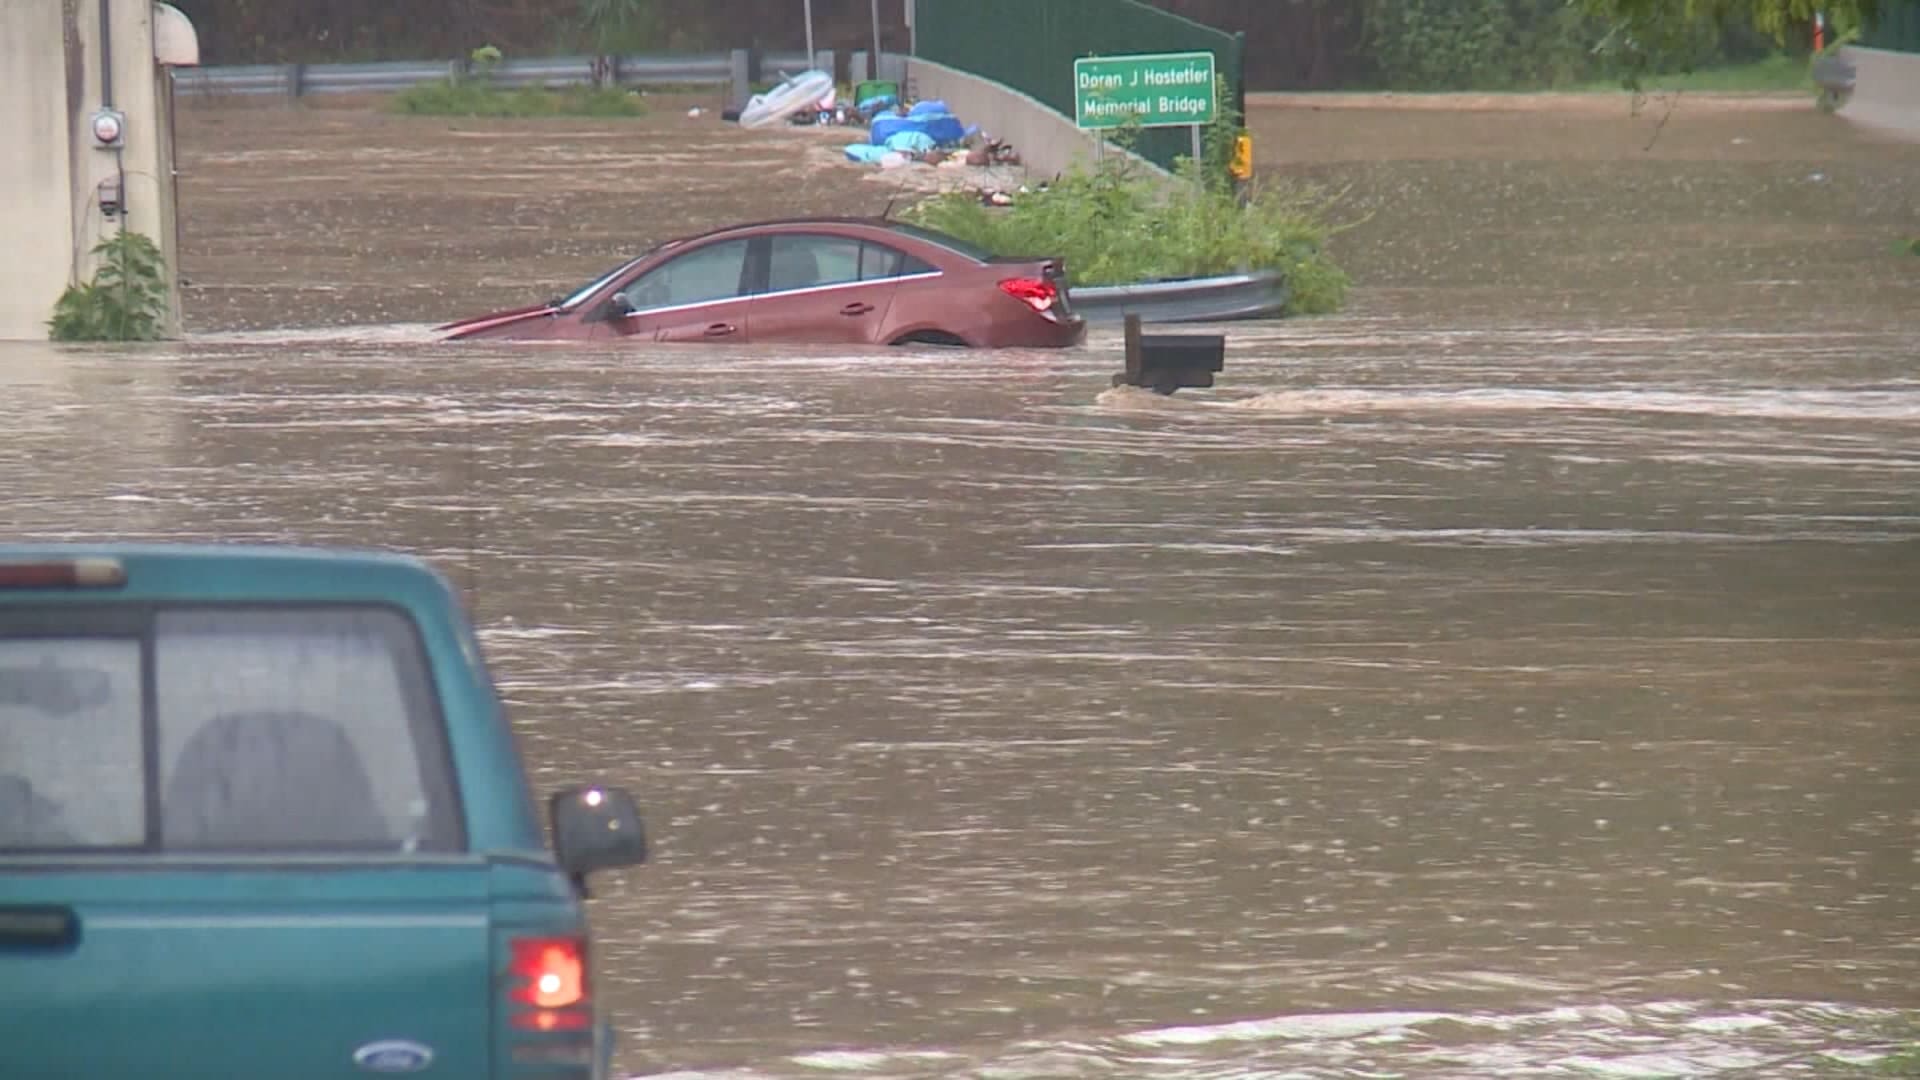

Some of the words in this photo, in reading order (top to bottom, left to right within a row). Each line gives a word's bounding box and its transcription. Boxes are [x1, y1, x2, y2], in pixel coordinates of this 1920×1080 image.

[1079, 72, 1122, 88] Doran
[1129, 69, 1138, 86] J
[1085, 97, 1151, 115] Memorial
[1159, 96, 1207, 116] Bridge
